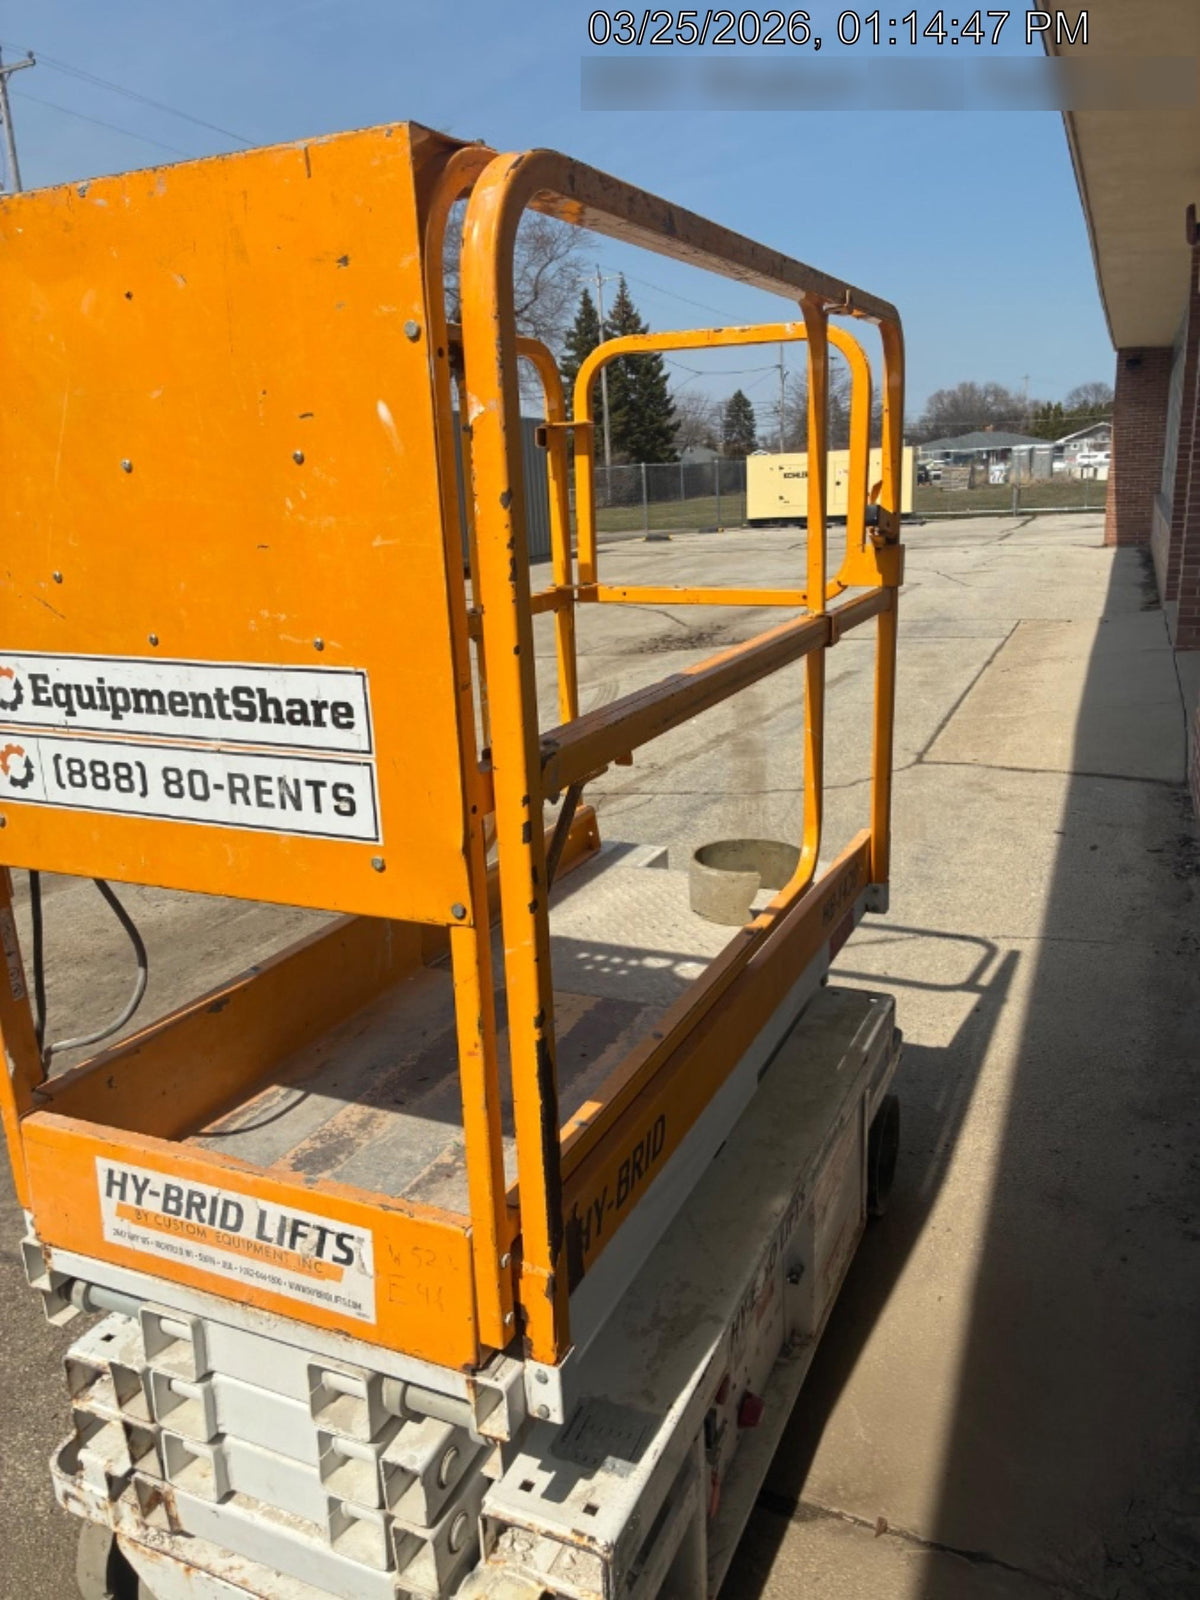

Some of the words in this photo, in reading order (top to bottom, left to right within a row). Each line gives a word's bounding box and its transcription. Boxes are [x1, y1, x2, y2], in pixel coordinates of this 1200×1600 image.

[28, 673, 355, 730] EquipmentShare
[52, 753, 148, 798] (888)
[162, 767, 356, 817] 80-RENTS
[105, 1167, 244, 1233] HY-BRID
[256, 1208, 355, 1266] LIFTS
[135, 1208, 149, 1221] BY
[154, 1214, 207, 1238] CUSTOM
[215, 1231, 290, 1264] EQUIPMENT
